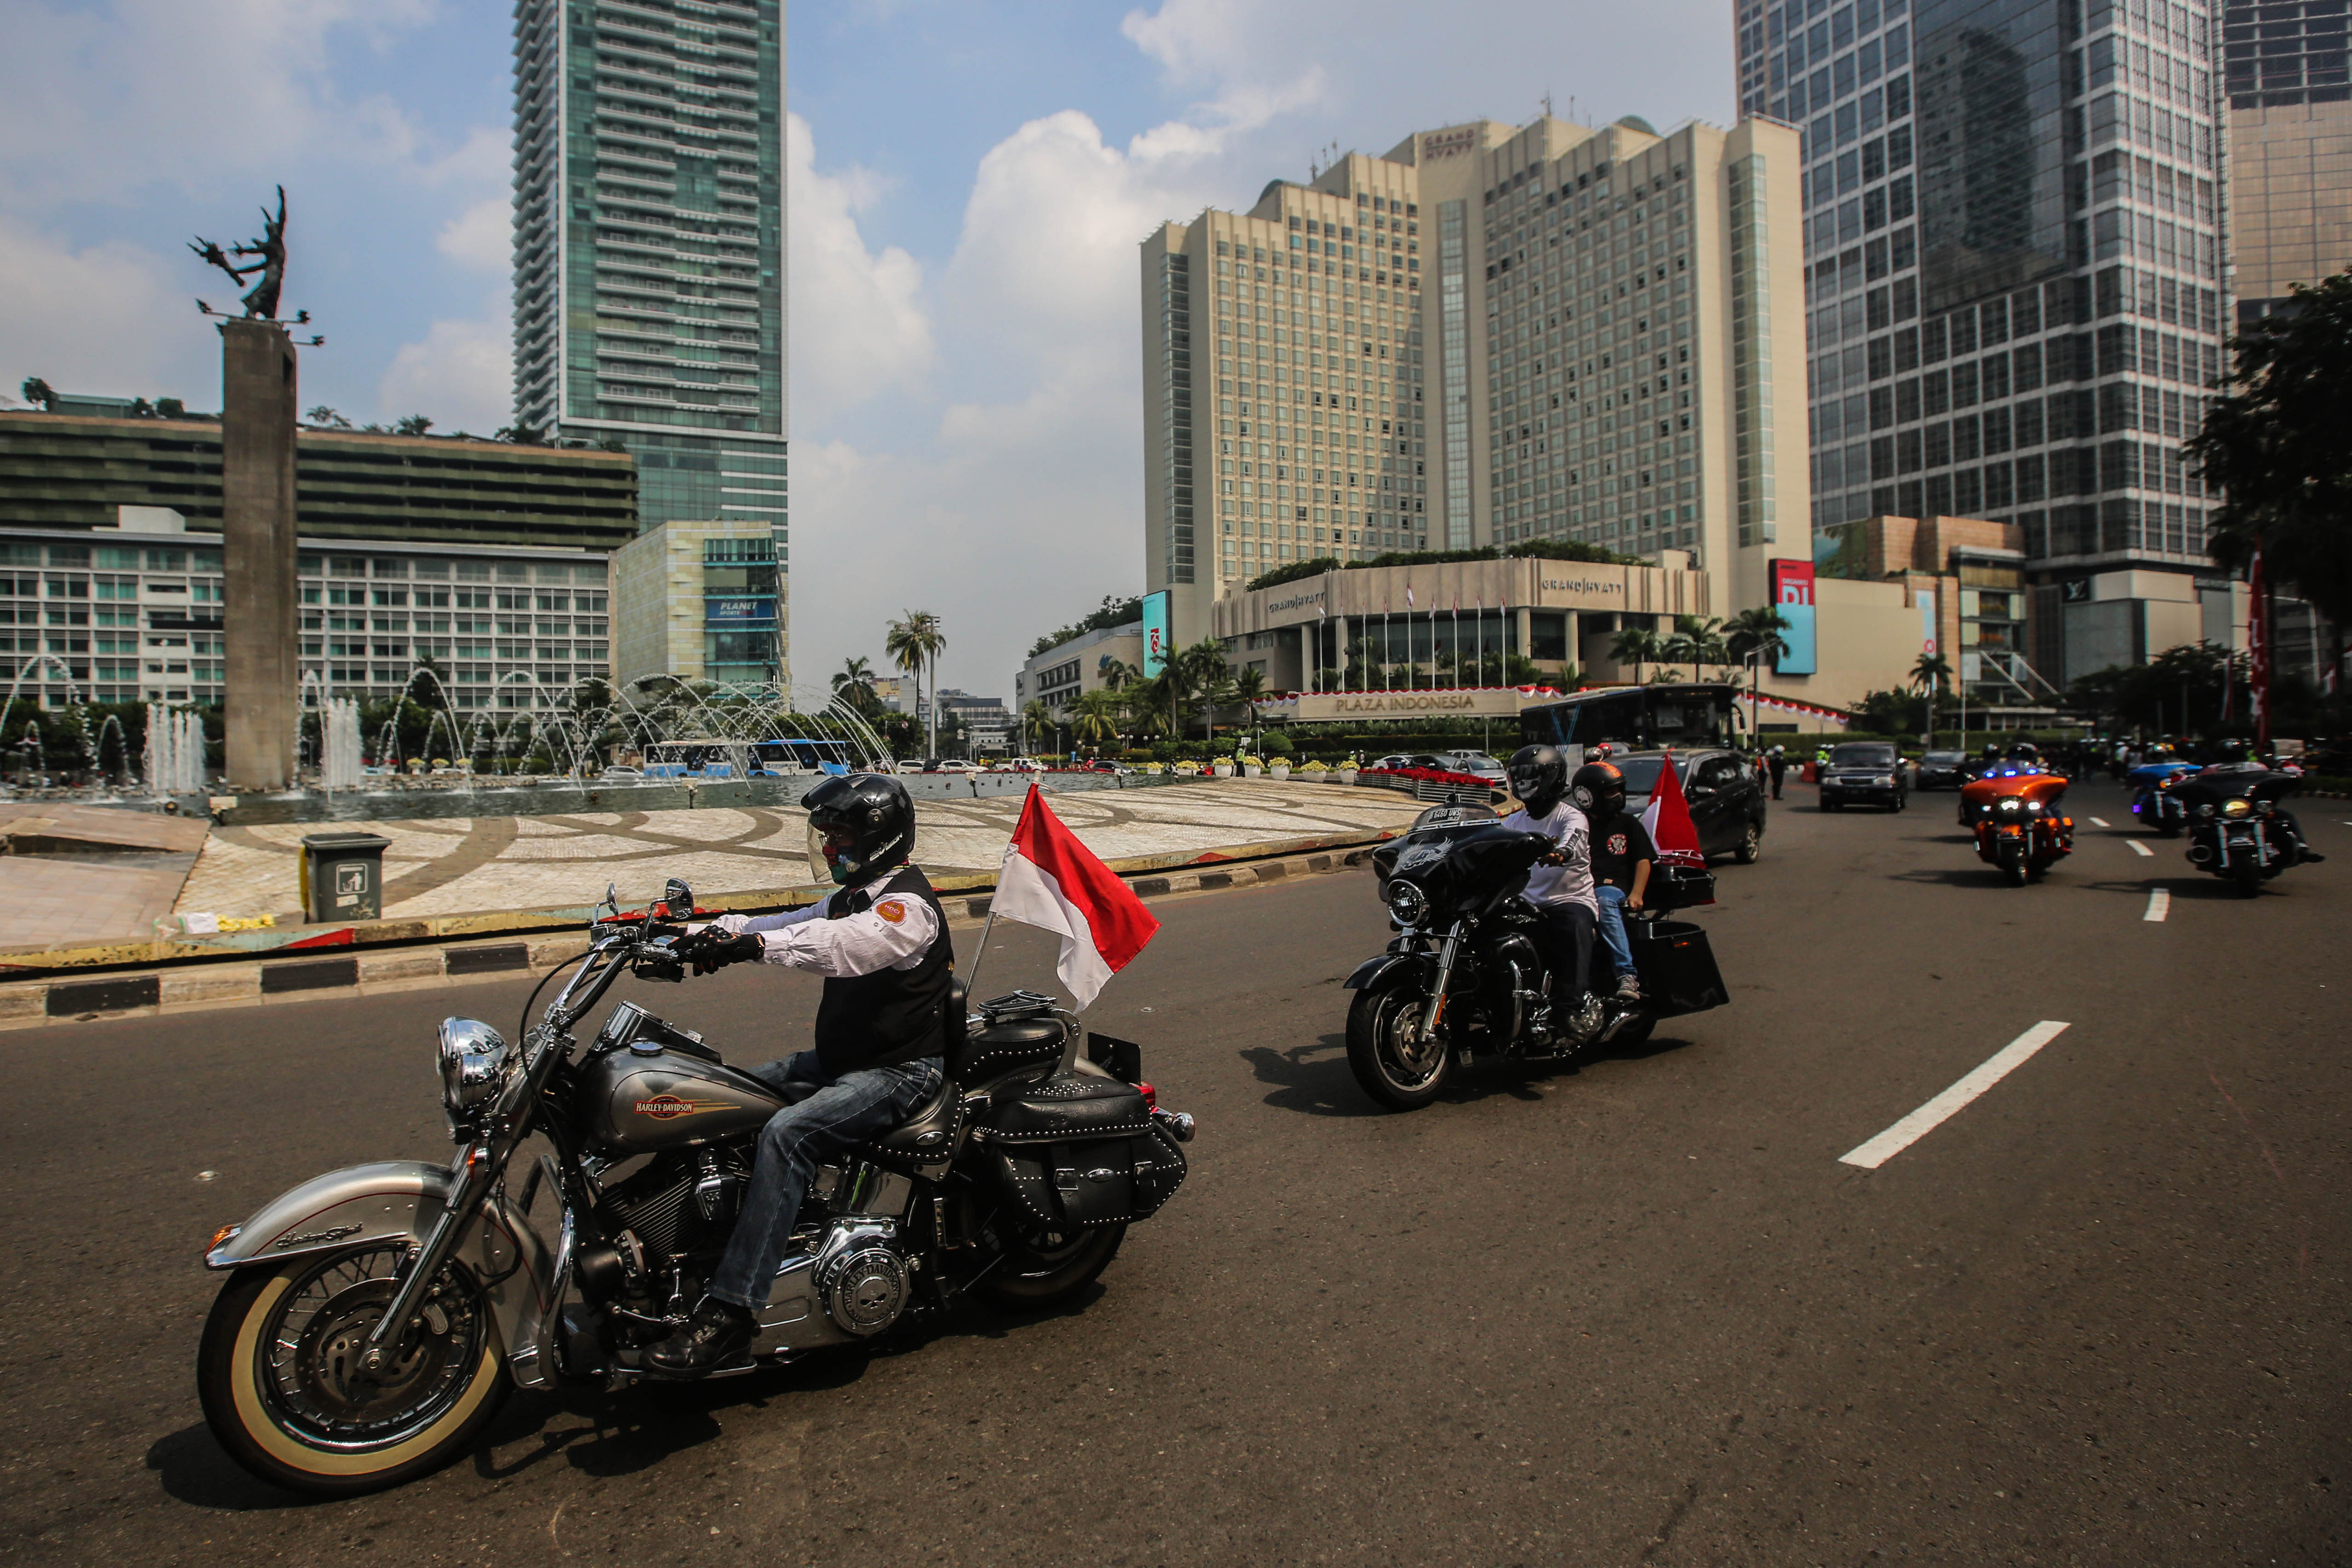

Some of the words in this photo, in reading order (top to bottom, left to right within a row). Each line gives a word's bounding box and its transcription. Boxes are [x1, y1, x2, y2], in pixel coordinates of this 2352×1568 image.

[1542, 578, 1583, 592] GRAND
[1587, 581, 1623, 594] HYATT
[720, 602, 758, 610] PLANET
[1269, 599, 1296, 613] GRAND
[1298, 591, 1325, 606] HYATT
[1336, 698, 1386, 712] PLAZA
[1390, 695, 1475, 710] INDONESIA
[884, 904, 900, 914] HDCI
